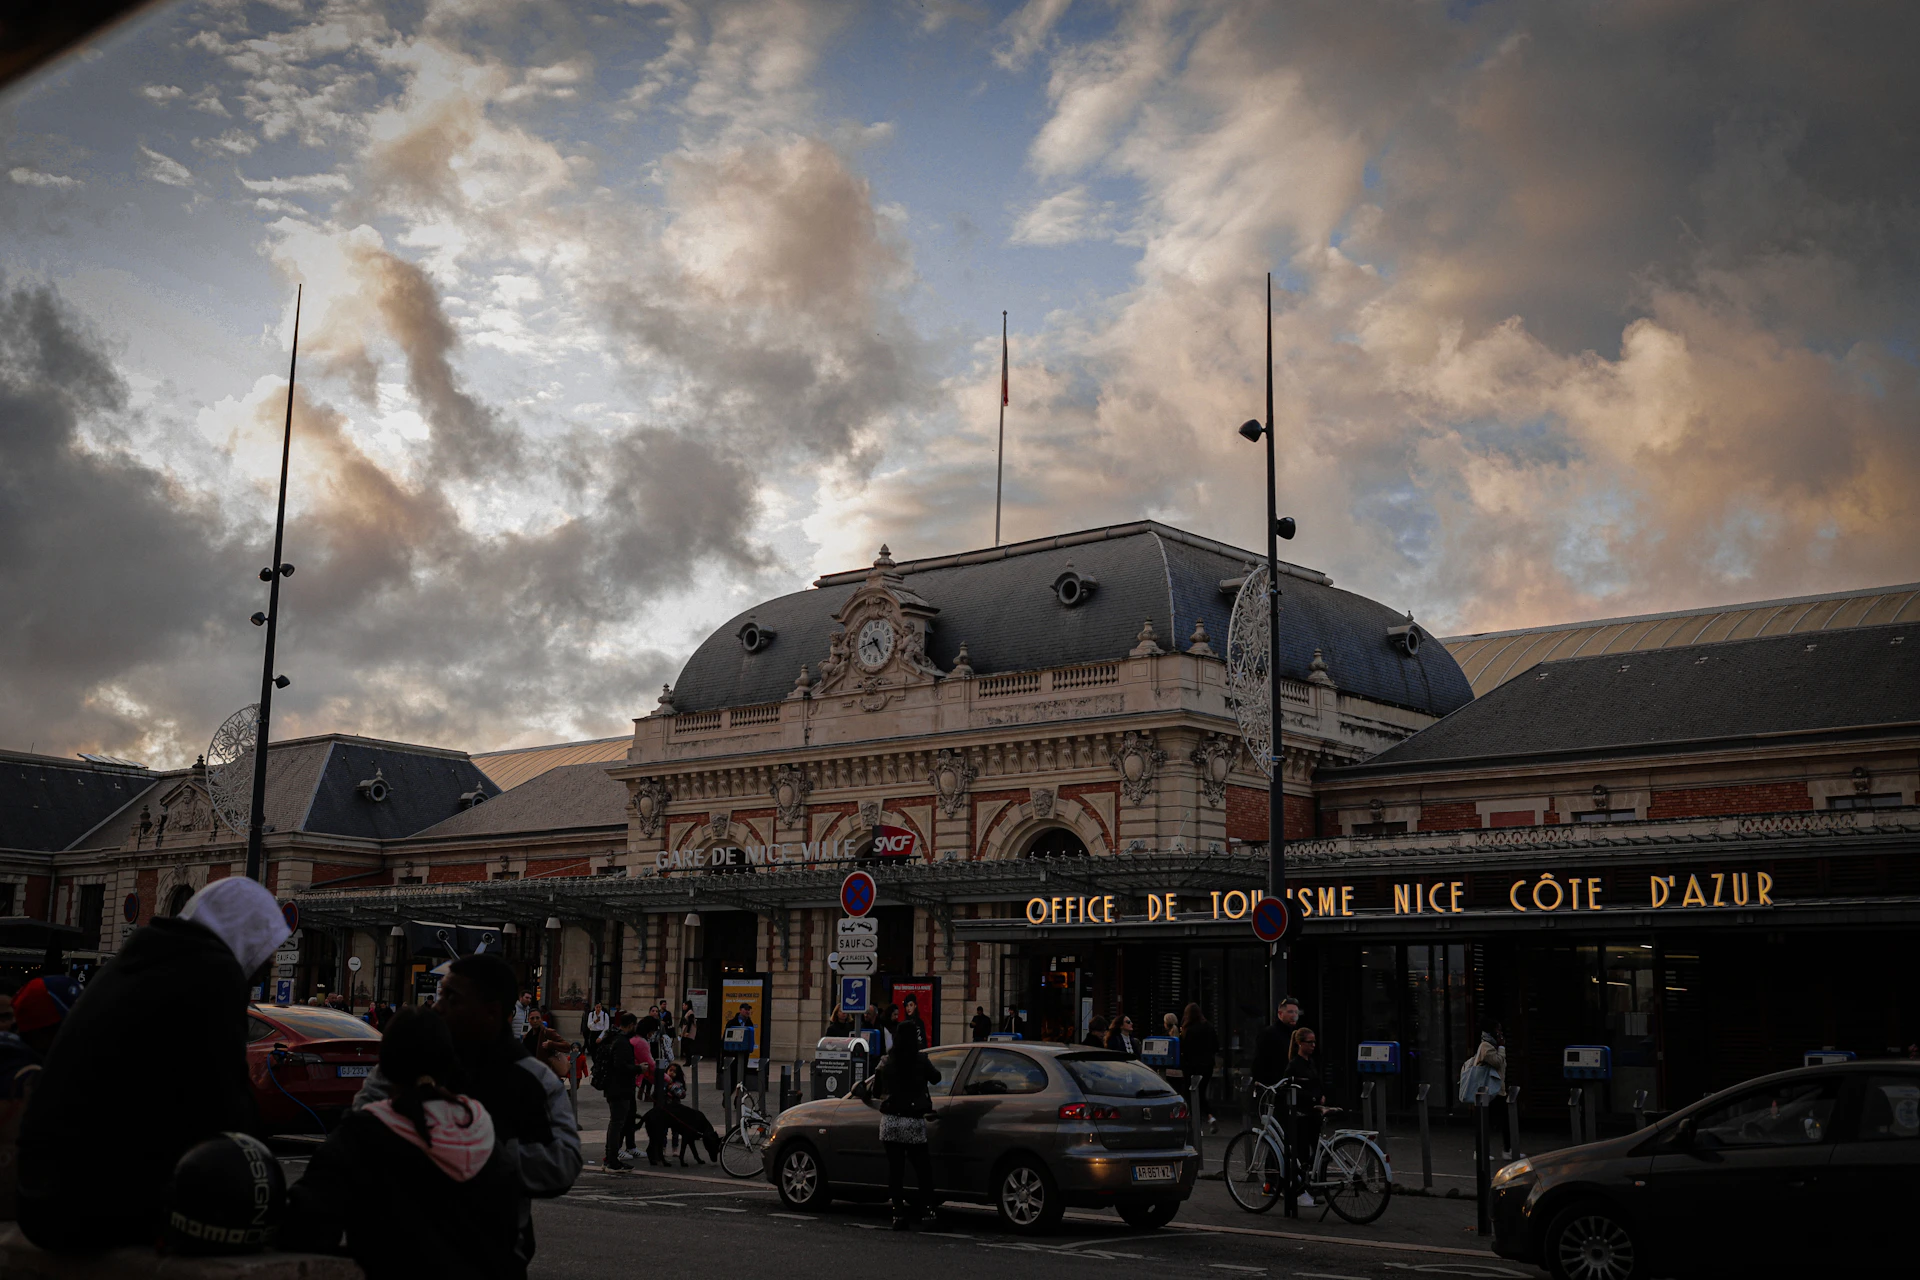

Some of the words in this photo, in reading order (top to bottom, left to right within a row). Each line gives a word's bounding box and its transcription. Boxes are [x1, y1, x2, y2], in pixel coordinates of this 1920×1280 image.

[655, 848, 705, 869] GARE
[711, 846, 738, 866] DE
[744, 843, 794, 864] NICE
[801, 838, 856, 861] VILLE
[872, 834, 913, 853] SNCF
[1026, 895, 1116, 925] OFFICE
[1147, 892, 1178, 922] DE
[1209, 884, 1355, 920] TOUSME
[1393, 881, 1465, 915] NICE
[1509, 872, 1603, 912] CÔTE
[1650, 871, 1775, 909] D'AZUR
[839, 939, 861, 949] SAUF
[235, 1137, 271, 1226] DESIGN
